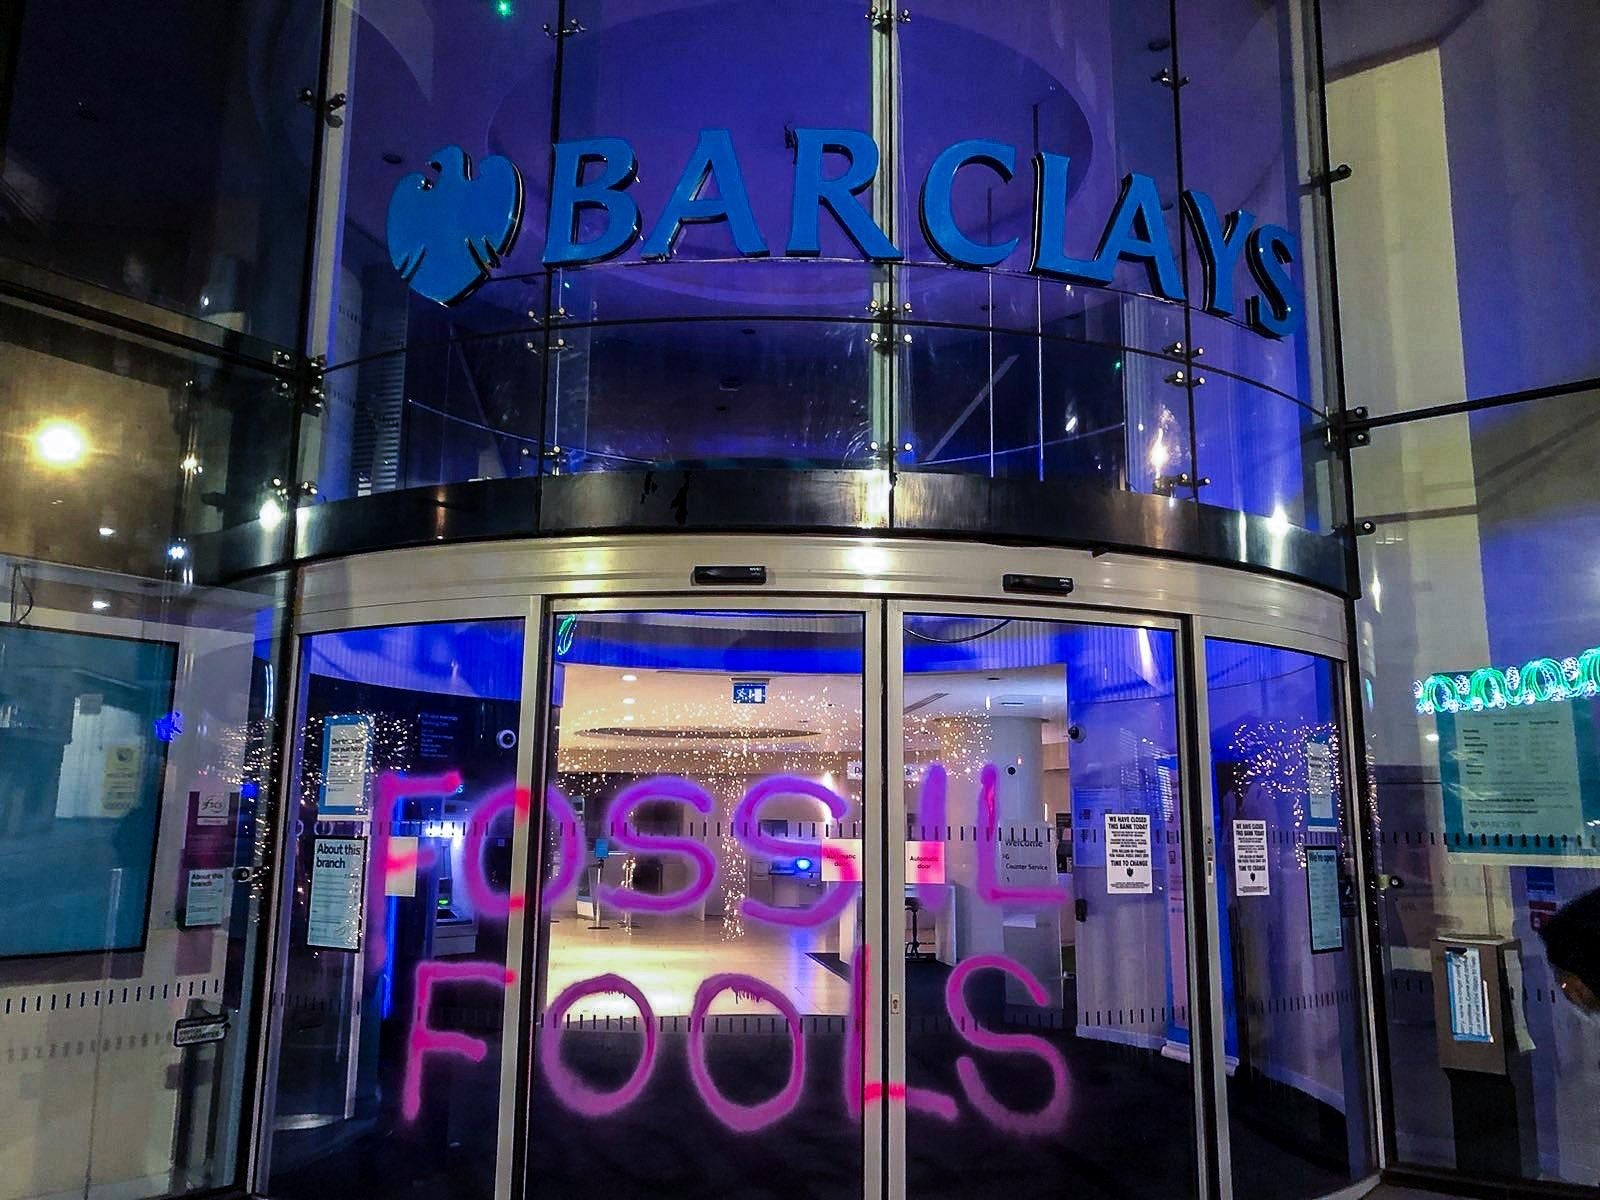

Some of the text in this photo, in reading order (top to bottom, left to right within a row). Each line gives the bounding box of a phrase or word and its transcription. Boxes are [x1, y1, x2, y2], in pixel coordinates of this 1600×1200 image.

[542, 127, 1299, 338] BARCLAYS
[316, 844, 361, 856] About this
[316, 858, 346, 869] branch
[366, 763, 1068, 970] FOSSIL
[1005, 839, 1044, 848] Welcome
[402, 945, 1071, 1135] FOOLS
